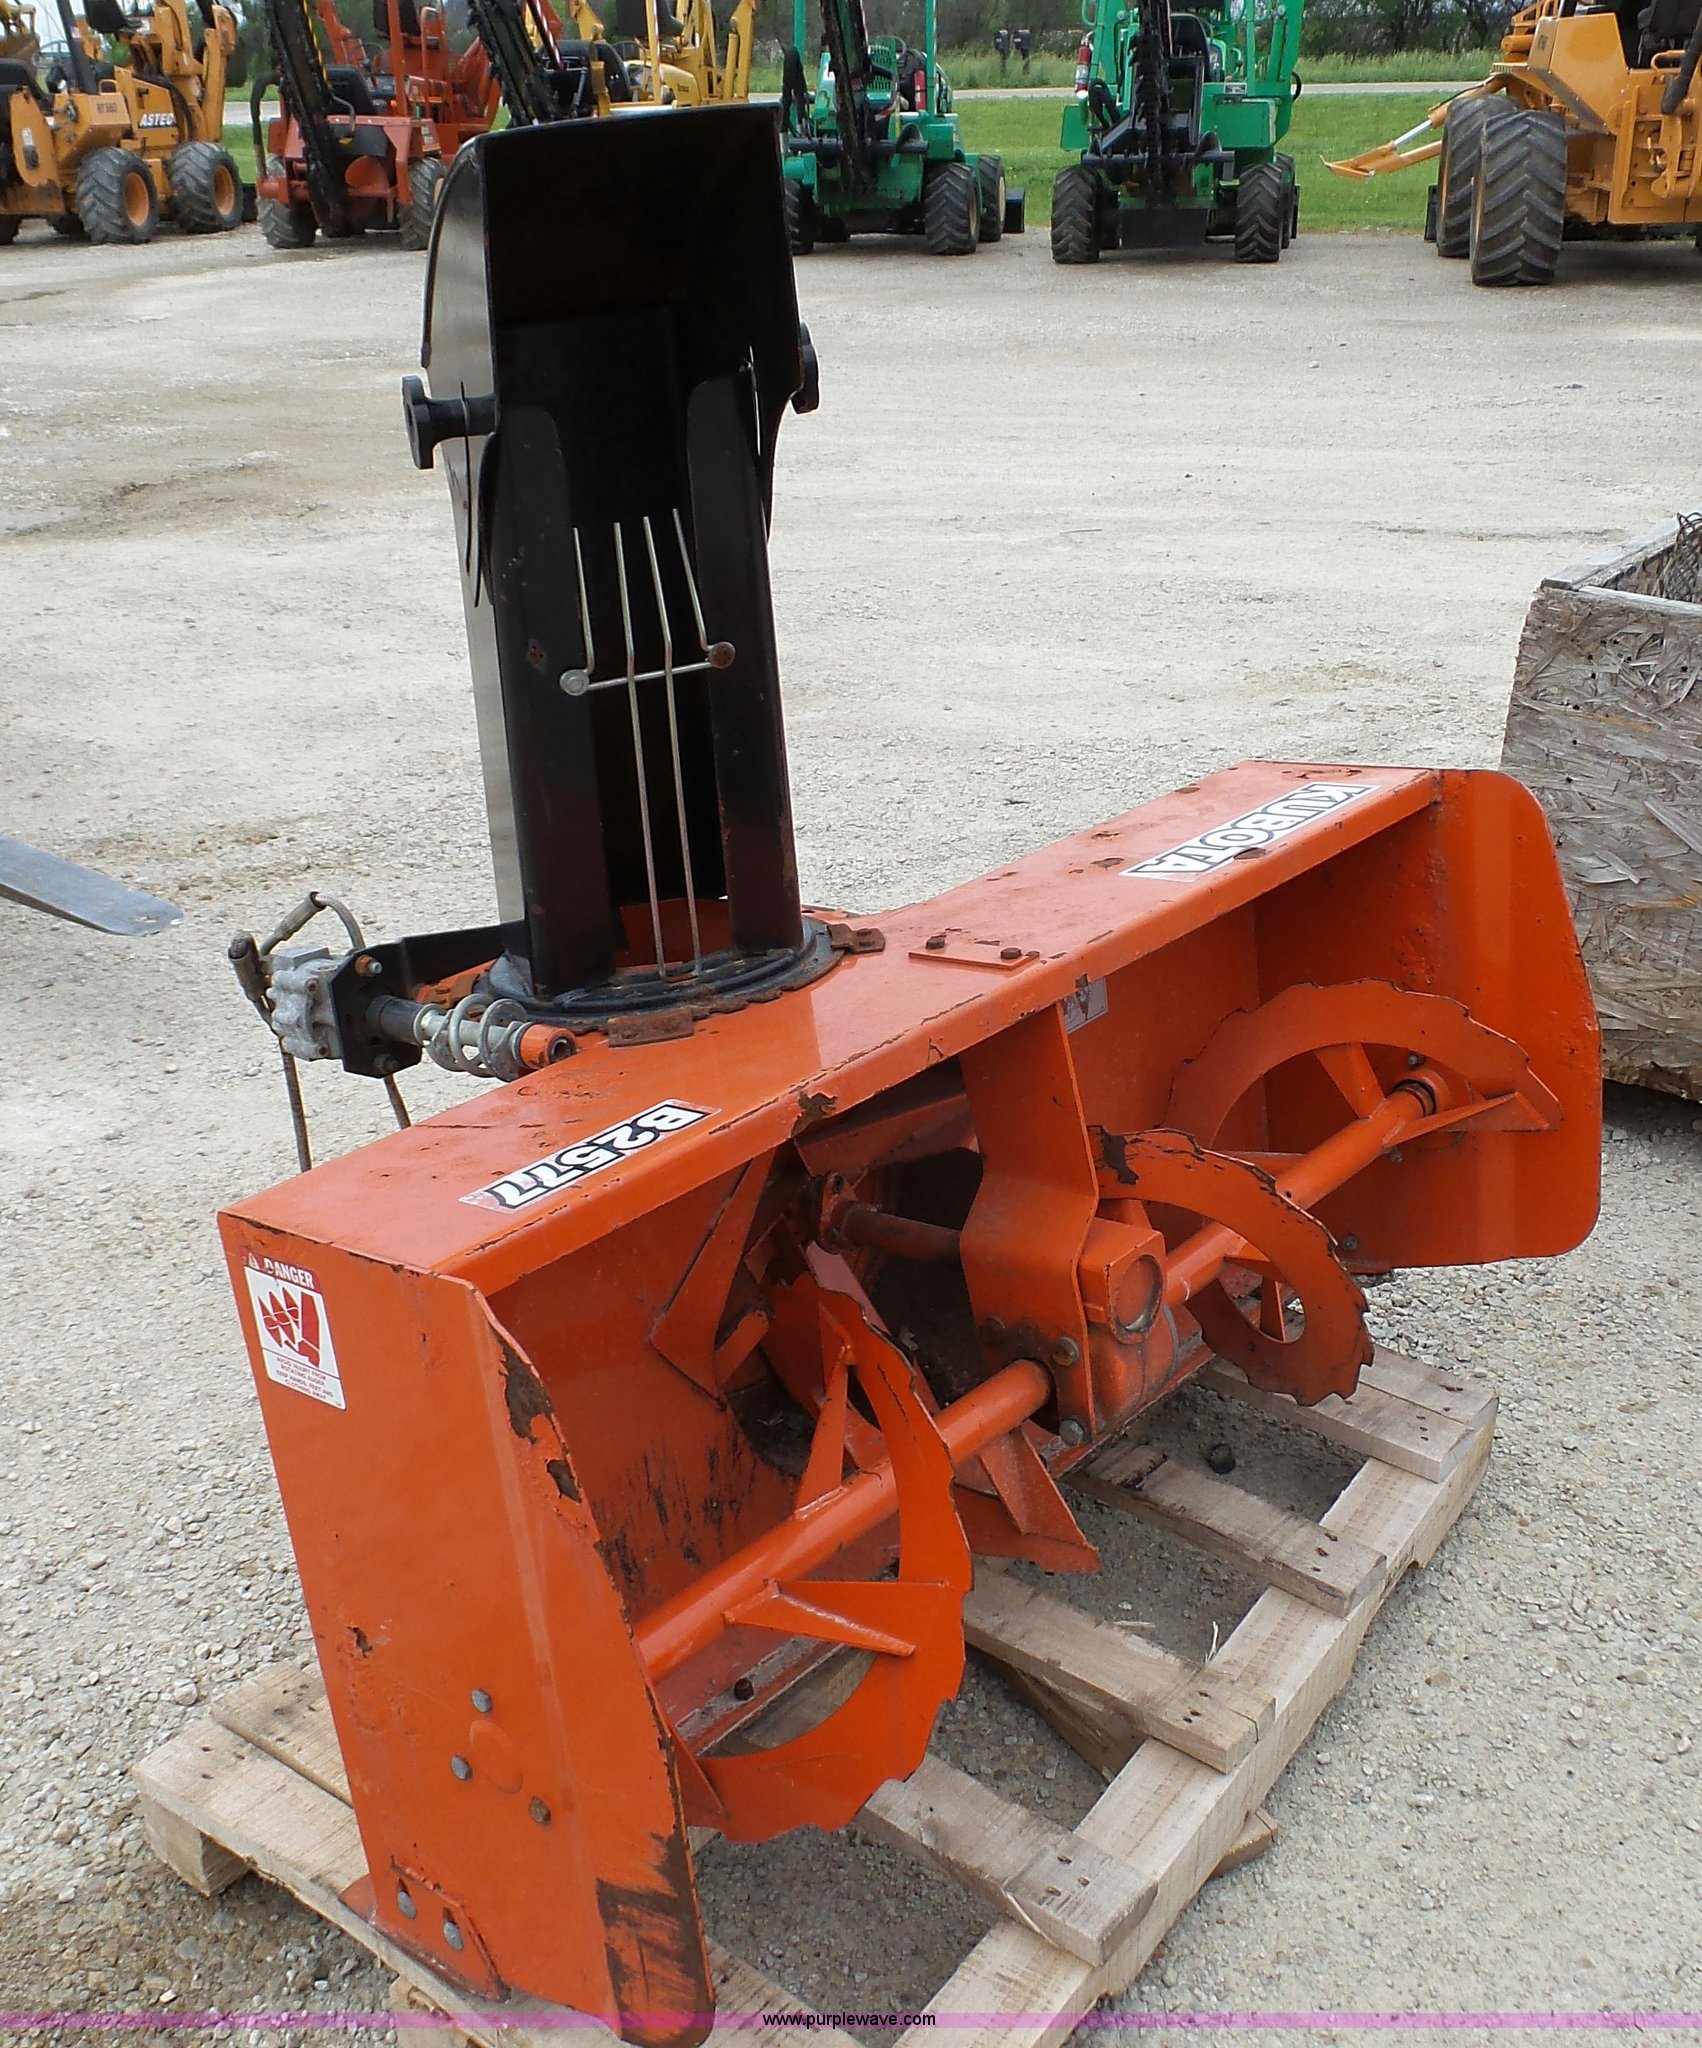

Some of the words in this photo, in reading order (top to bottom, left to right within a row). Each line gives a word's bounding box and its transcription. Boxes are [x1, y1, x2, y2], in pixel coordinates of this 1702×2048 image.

[139, 112, 176, 129] ASTEC
[1127, 783, 1373, 873] KUBOTA
[484, 1103, 713, 1210] B2577
[263, 1257, 315, 1290] DANGER
